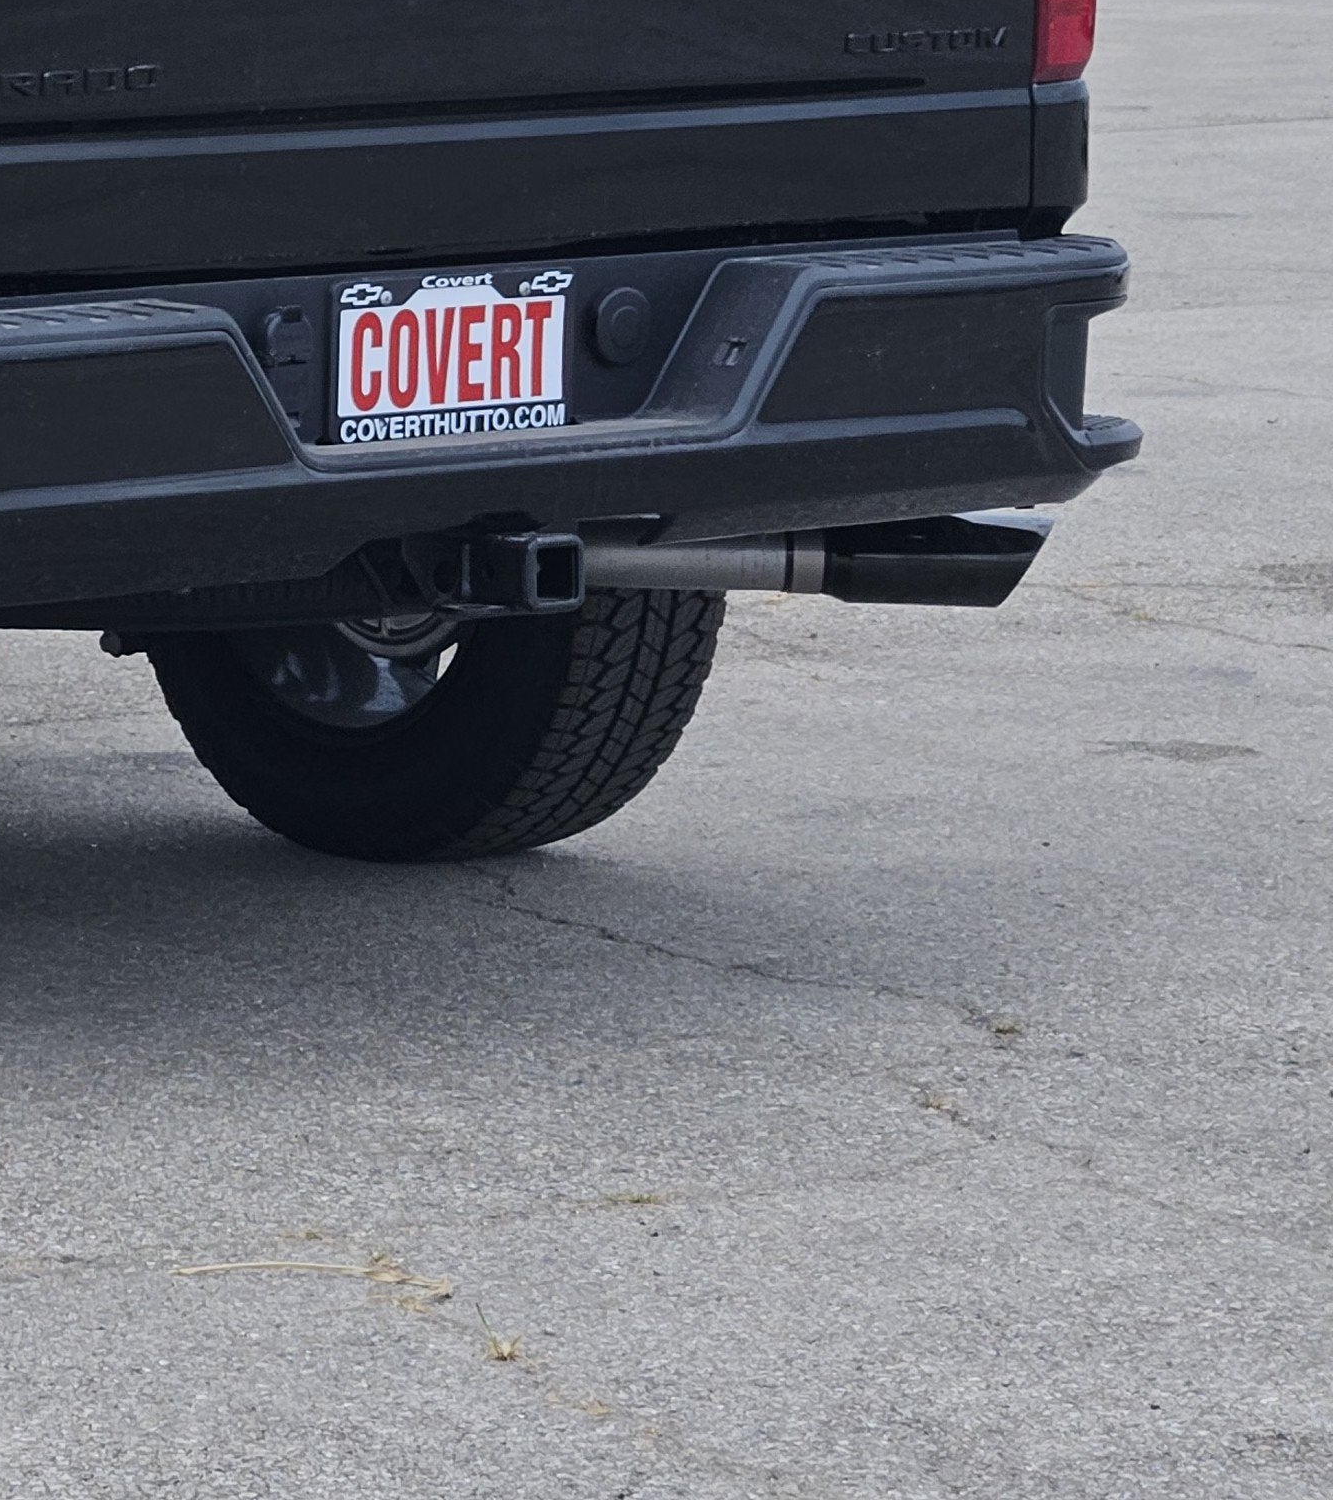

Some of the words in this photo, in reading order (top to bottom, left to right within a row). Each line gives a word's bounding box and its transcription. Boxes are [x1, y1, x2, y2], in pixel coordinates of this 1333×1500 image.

[421, 271, 493, 289] Covert
[350, 299, 553, 412] COVERT
[339, 403, 566, 445] COVERTHUTTO.COM
